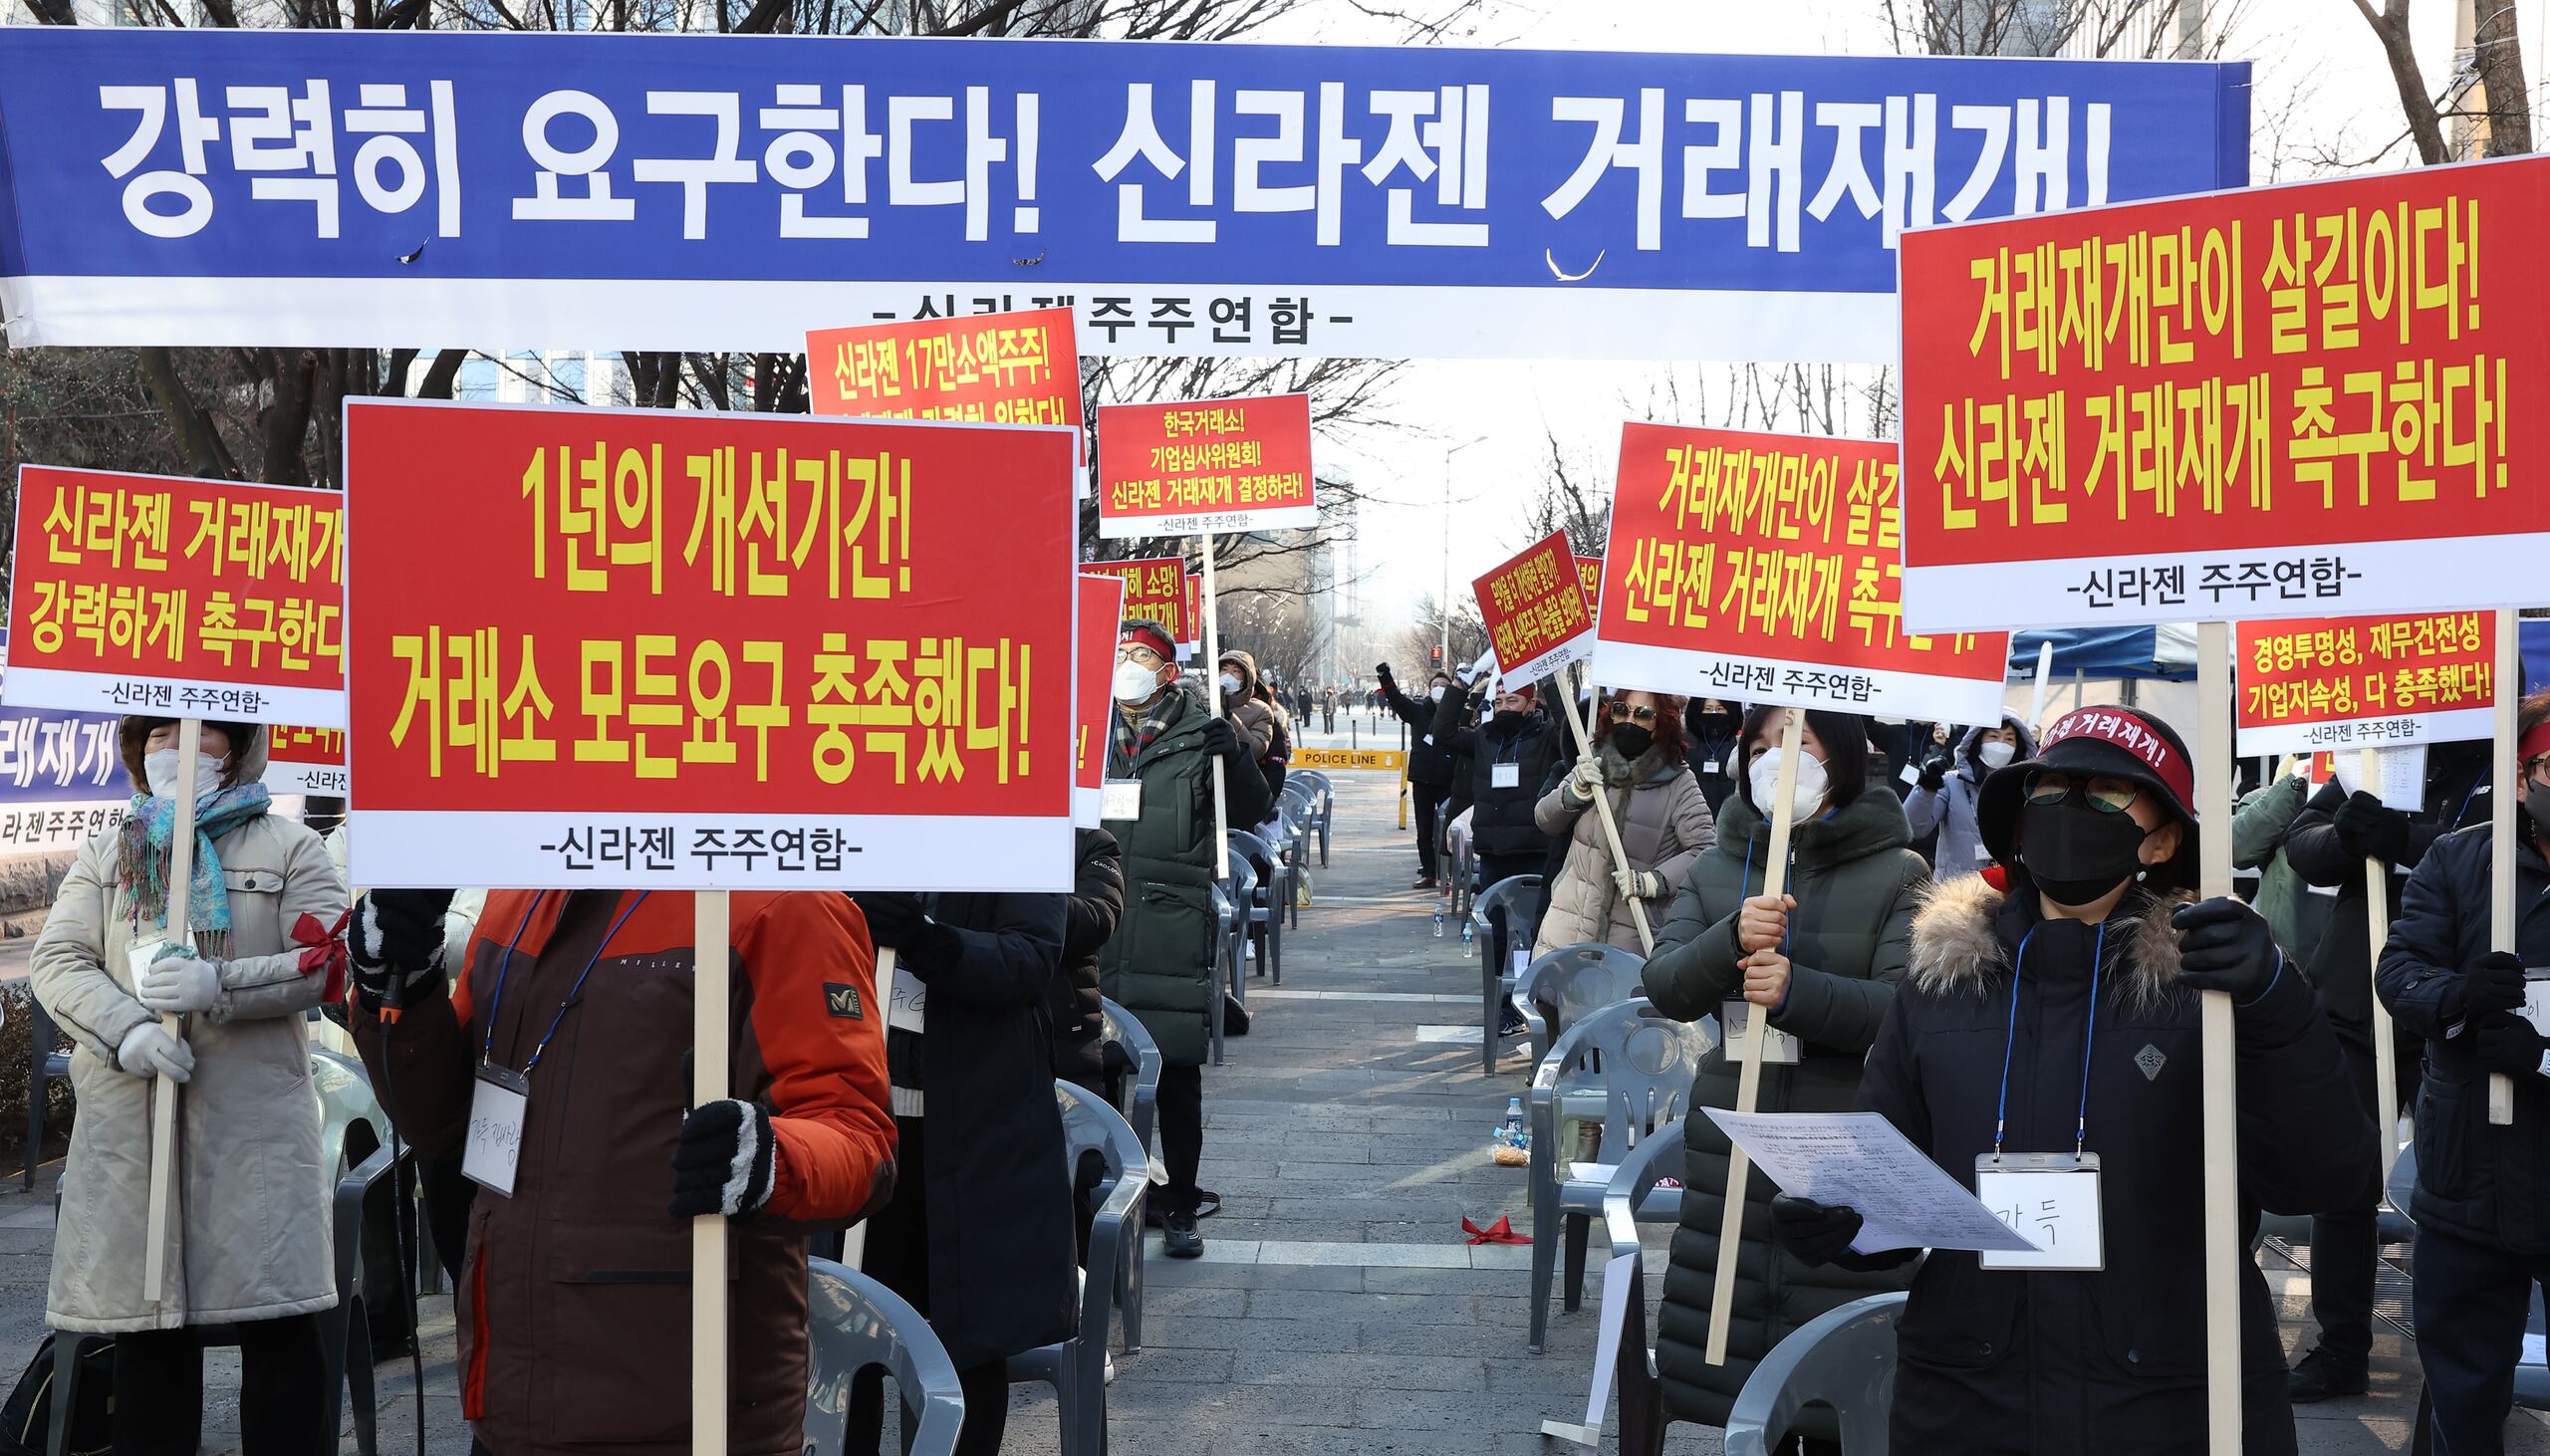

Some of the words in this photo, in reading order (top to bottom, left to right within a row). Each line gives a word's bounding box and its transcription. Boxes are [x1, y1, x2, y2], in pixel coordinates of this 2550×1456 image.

[100, 78, 460, 238] 강력히
[513, 85, 1039, 241] 요구한다!
[1092, 80, 1489, 246] 신라젠
[1970, 220, 2242, 378] 거래재개만이
[2263, 197, 2479, 354] 살길이다!
[835, 337, 901, 400] 신라젠
[905, 326, 1051, 391] 17만소액주주!
[1163, 408, 1244, 438] 한국거래소!
[1934, 390, 2067, 528] 신라젠
[2085, 373, 2271, 519] 거래재개
[2289, 356, 2507, 507] 촉구한다!
[1150, 440, 1261, 473] 기업심사위원회!
[1112, 479, 1161, 510] 신라젠
[1166, 475, 1233, 507] 거래재개
[1237, 472, 1303, 504] 결정하라!
[1659, 445, 1838, 542] 거래재개만이
[44, 486, 170, 571] 신라젠
[523, 442, 661, 594] 1년의
[684, 446, 910, 598] 개선기간!
[1147, 565, 1179, 598] 소망!
[1626, 538, 1715, 627] 신라젠
[1720, 548, 1843, 641] 거래재개
[2068, 566, 2184, 607] -신라젠
[2199, 558, 2361, 603] 주주연합-
[31, 581, 186, 660] 강력하게
[1493, 618, 1520, 665] 신라젠
[2253, 627, 2364, 673] 경영투명성,
[2371, 613, 2480, 658] 재무건전성
[102, 682, 172, 708] -신라젠
[179, 687, 271, 714] 주주연합-
[390, 625, 556, 777] 거래소
[574, 635, 789, 781] 모든요구
[808, 633, 1029, 784] 충족했다!
[1700, 662, 1774, 691] -신라젠
[1780, 658, 1881, 701] 주주연합-
[2248, 675, 2359, 719] 기업지속성,
[2365, 671, 2387, 709] 다
[2394, 661, 2491, 707] 충족했다!
[1305, 753, 1347, 764] POLICE
[1351, 755, 1376, 765] LINE
[2074, 712, 2167, 768] 거래재개!
[2303, 724, 2352, 744] -신라젠
[2357, 718, 2422, 738] 주주연합-
[541, 827, 674, 869] -신라젠
[691, 829, 862, 870] 주주연합-
[620, 958, 696, 972] MILLE
